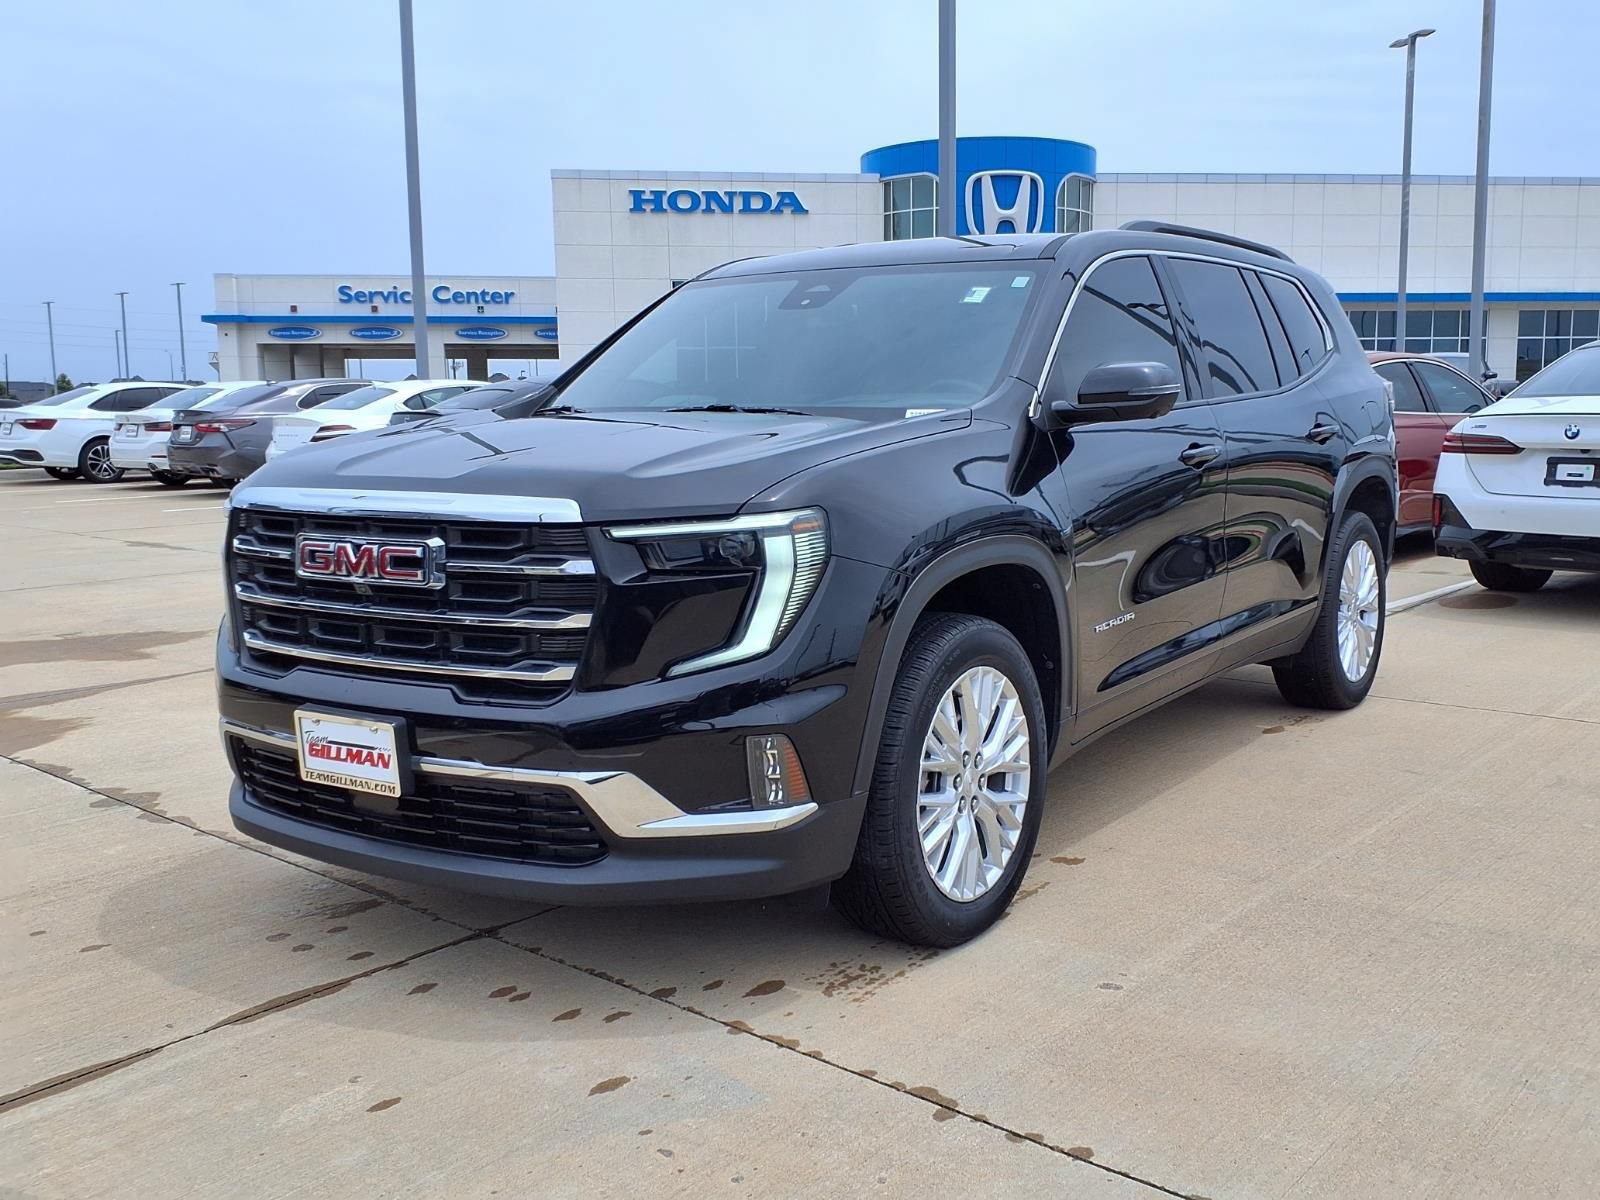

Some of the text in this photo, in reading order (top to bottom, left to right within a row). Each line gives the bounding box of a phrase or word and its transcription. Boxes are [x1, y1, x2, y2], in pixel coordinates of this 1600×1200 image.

[628, 189, 809, 215] HONDA
[337, 285, 515, 304] Servic Center
[300, 541, 424, 581] GMC
[1095, 612, 1136, 633] ACADIA
[304, 730, 329, 744] Team
[308, 742, 392, 769] GILLMAN
[304, 770, 396, 795] TEAMGILLMAN.COM
